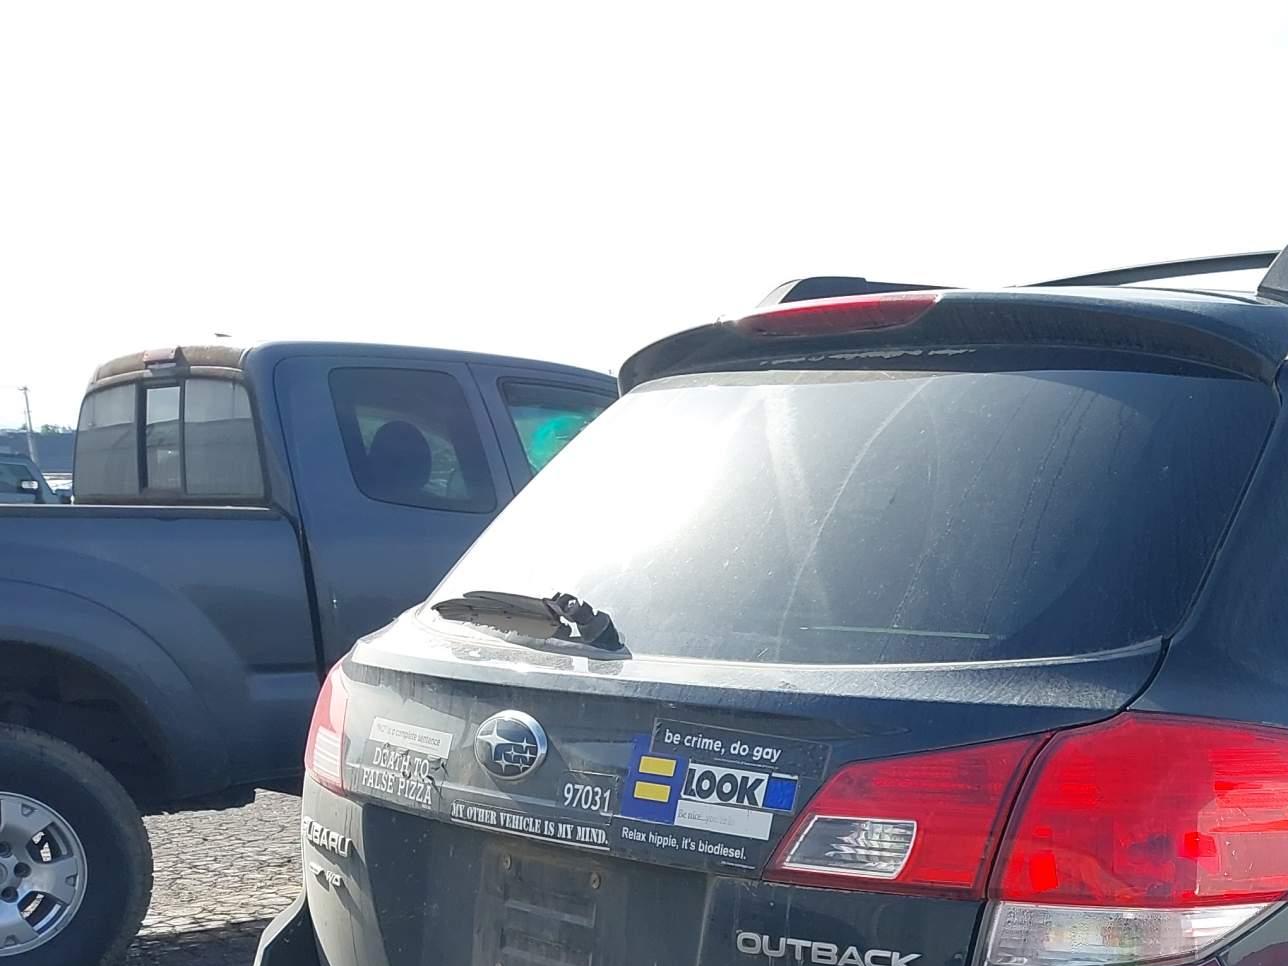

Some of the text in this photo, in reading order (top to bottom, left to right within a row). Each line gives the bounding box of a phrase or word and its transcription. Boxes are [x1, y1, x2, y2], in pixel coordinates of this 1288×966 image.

[373, 747, 430, 778] DEATH TO
[664, 729, 782, 762] be crime, do gay
[362, 767, 432, 805] FALSE PIZZA
[563, 782, 612, 813] 97031
[683, 768, 764, 806] LOOK
[451, 802, 464, 818] MY
[466, 806, 497, 825] OTHER
[499, 812, 541, 834] VEHICLE
[543, 821, 555, 836] IS
[557, 823, 574, 840] MY
[576, 826, 609, 845] MIND.
[622, 826, 747, 860] Relax hippie, it's biodiesel.
